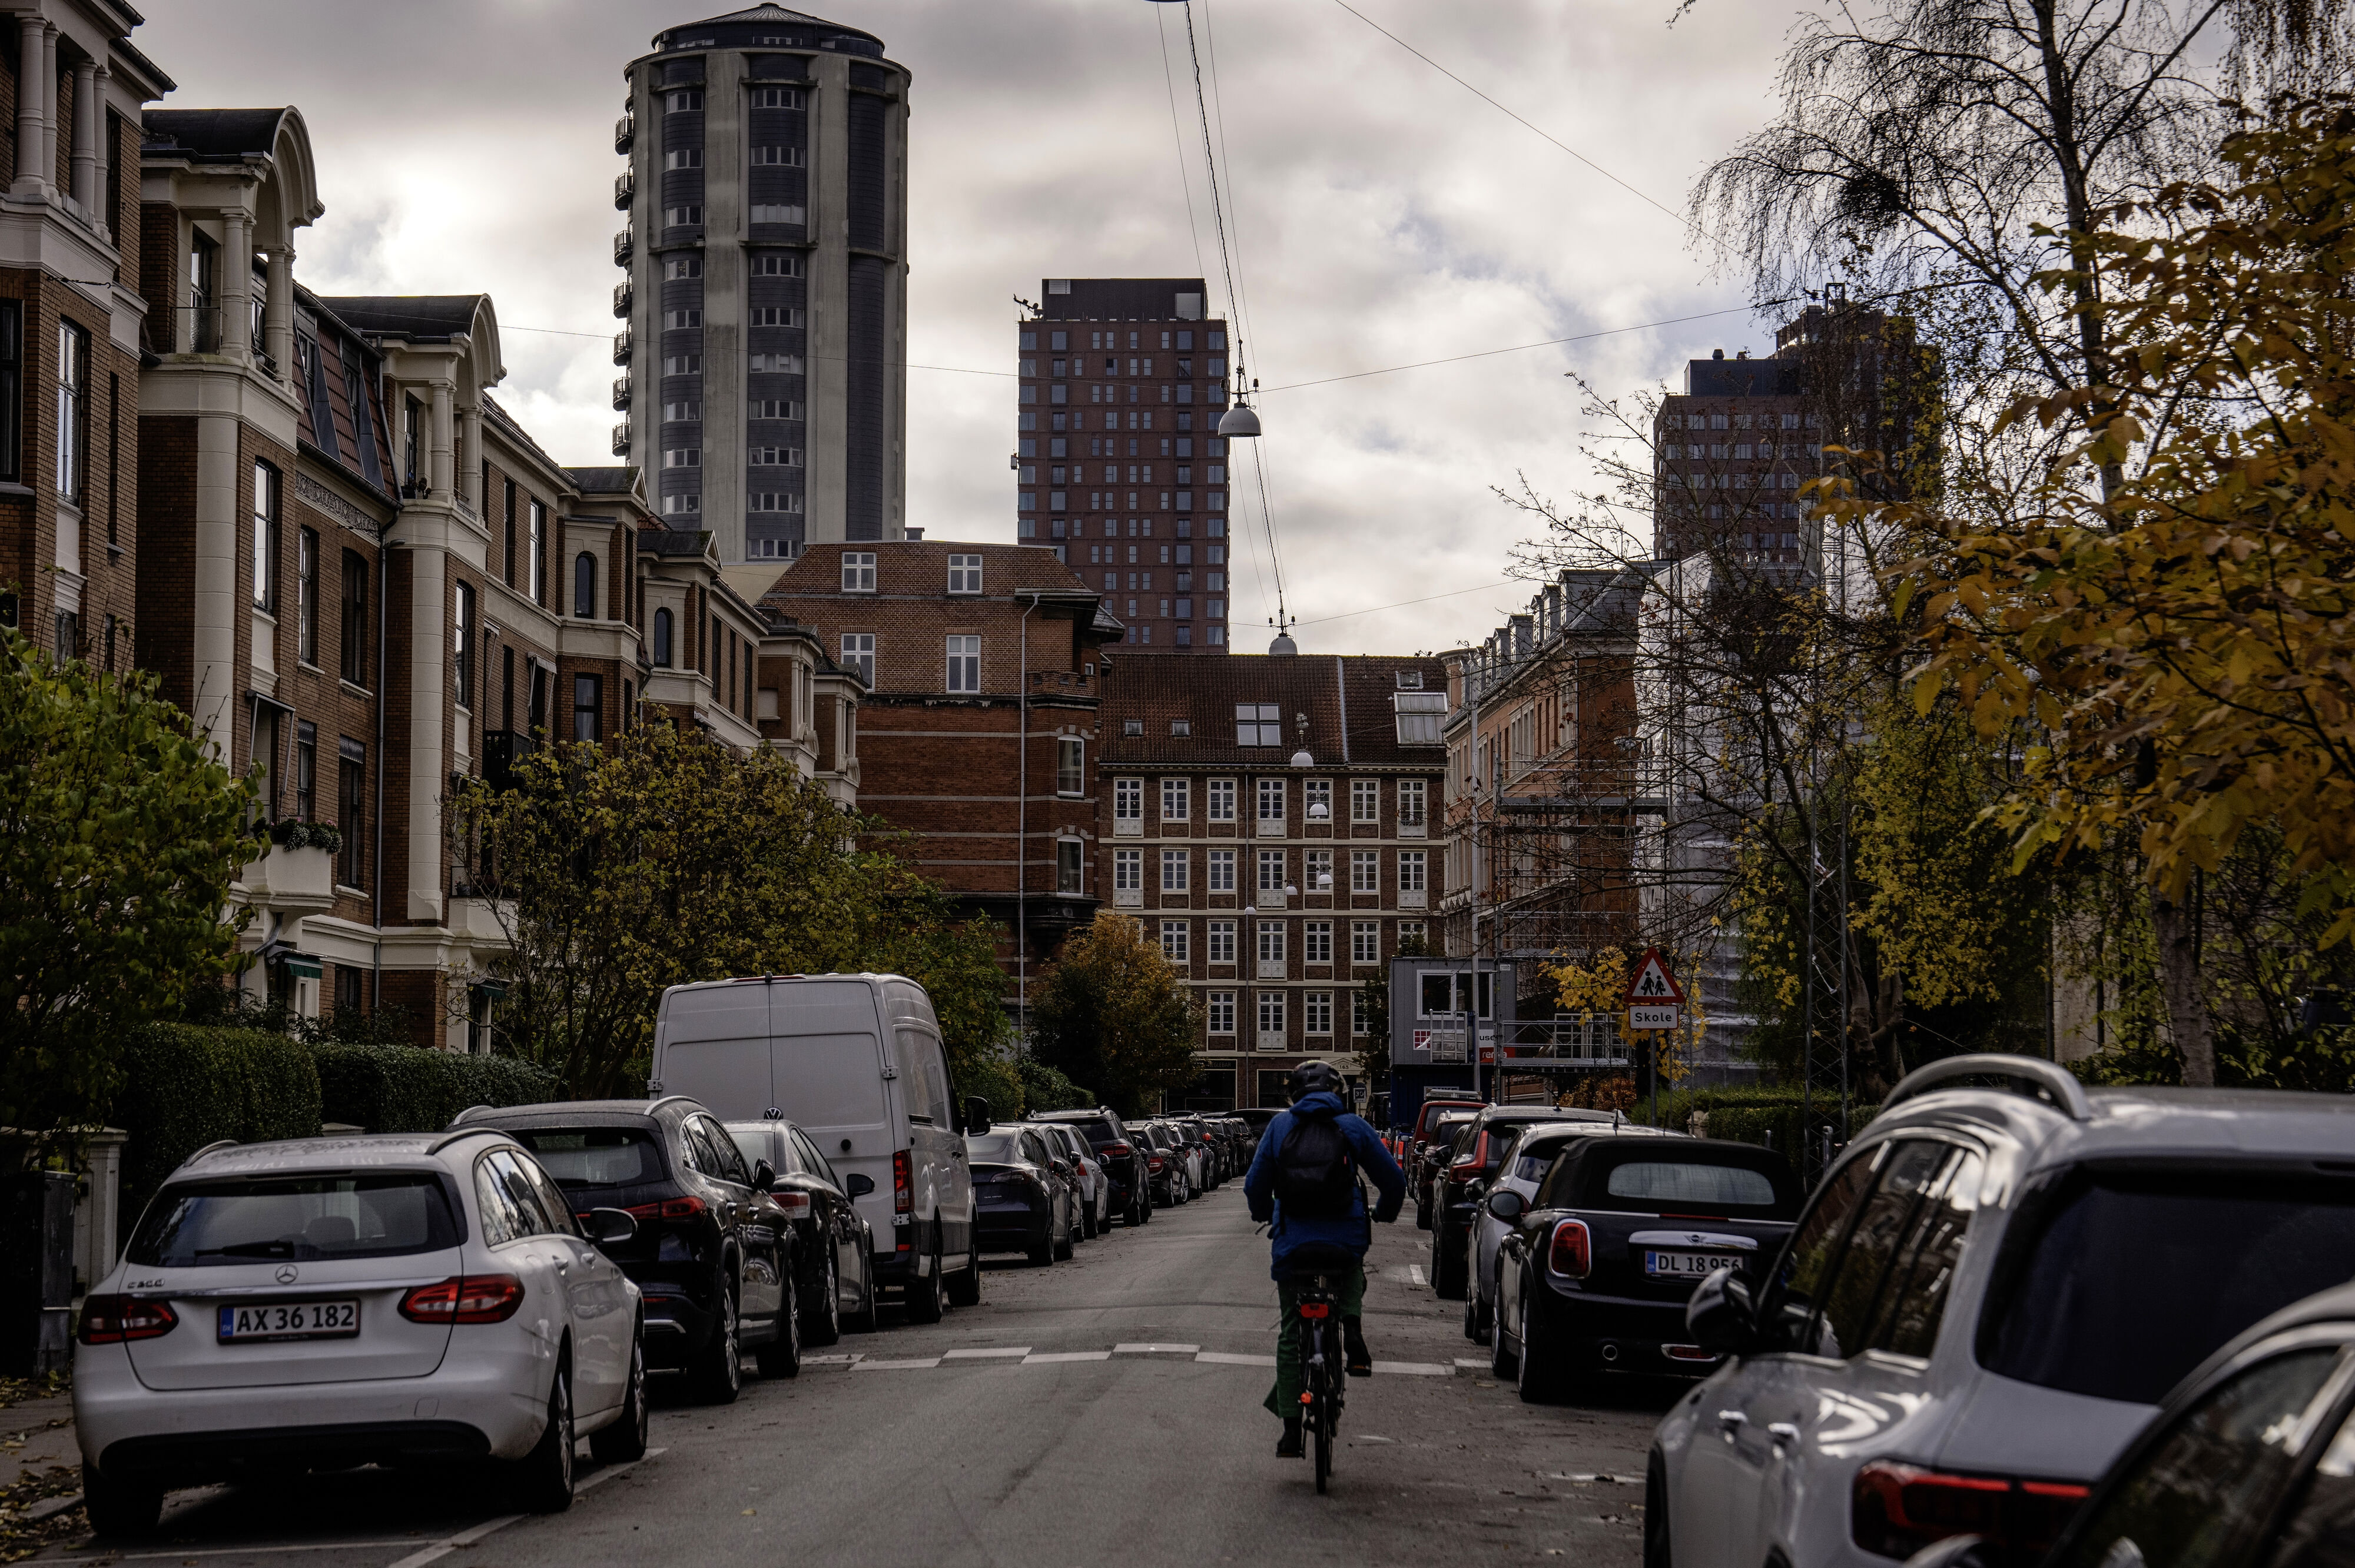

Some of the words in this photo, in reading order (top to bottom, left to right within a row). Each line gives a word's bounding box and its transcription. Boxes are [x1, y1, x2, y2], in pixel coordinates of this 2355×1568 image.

[1635, 1012, 1672, 1022] Skole
[1659, 1255, 1680, 1271] DL
[1687, 1257, 1706, 1272] 18
[1710, 1258, 1740, 1270] 956
[237, 1309, 268, 1331] AX
[275, 1306, 304, 1330] 36
[313, 1304, 354, 1328] 182
